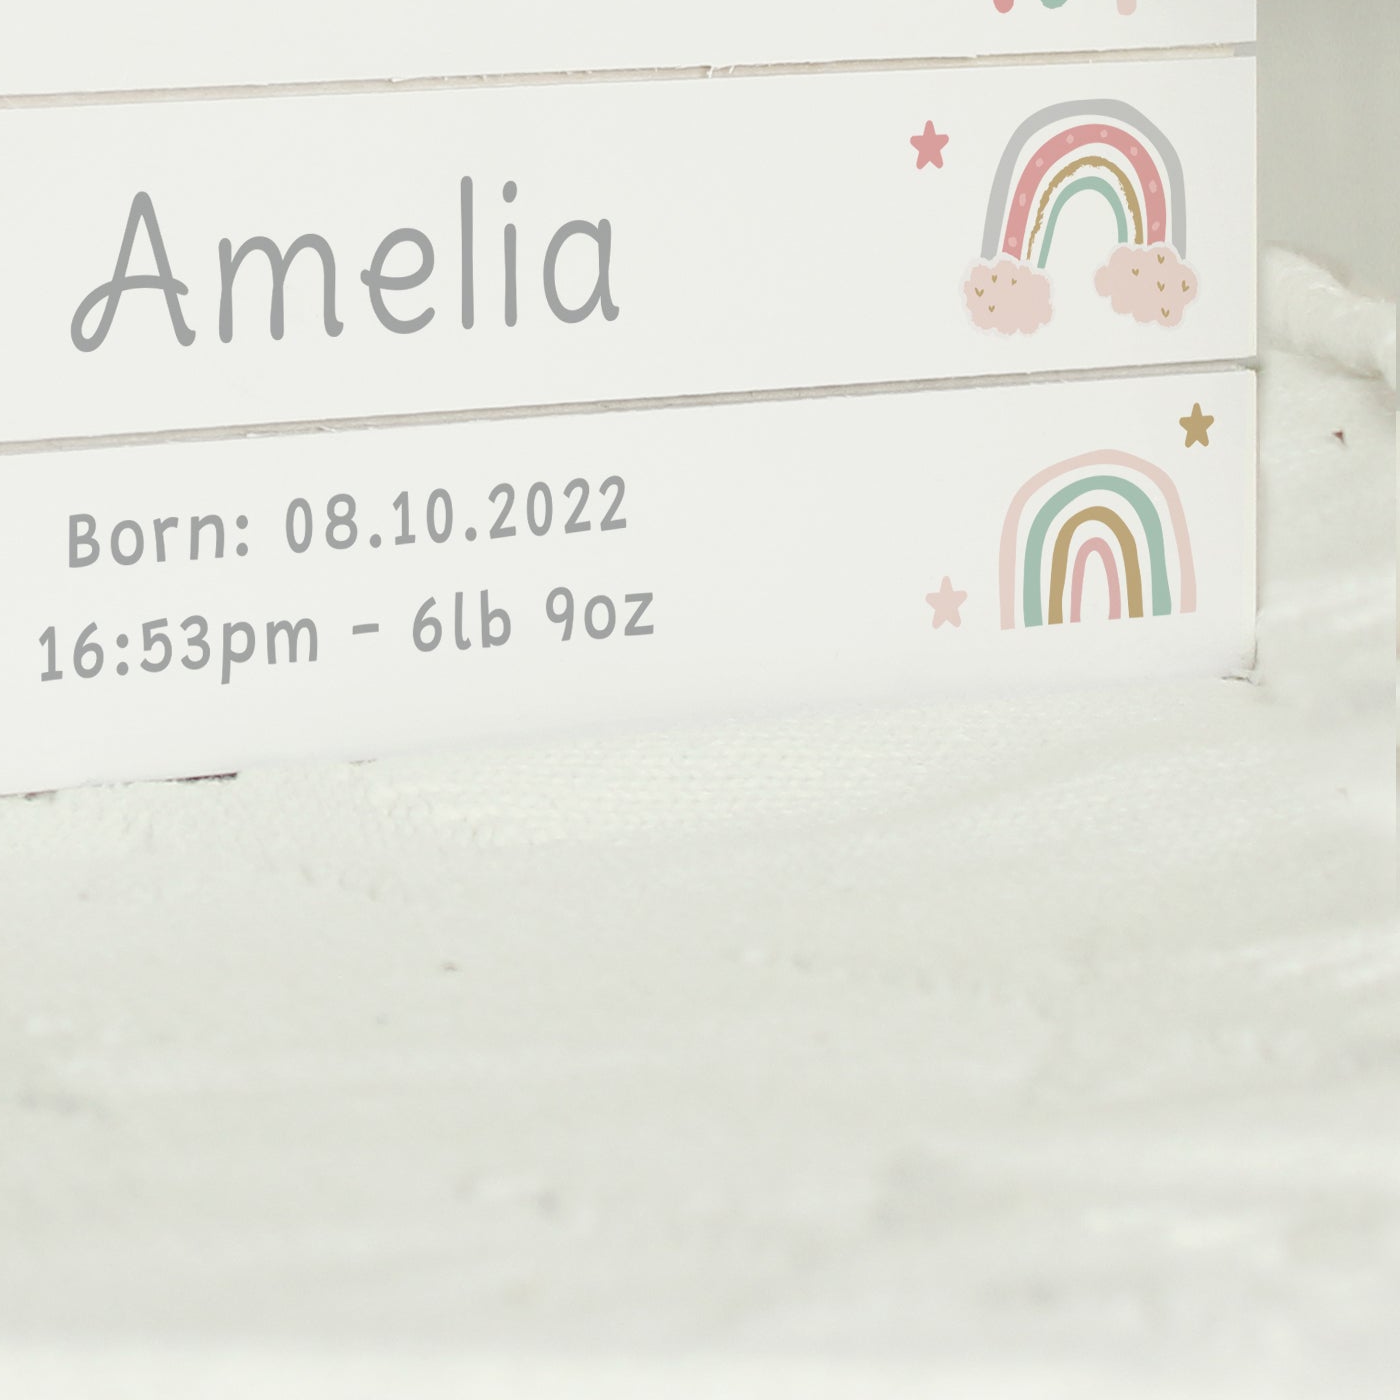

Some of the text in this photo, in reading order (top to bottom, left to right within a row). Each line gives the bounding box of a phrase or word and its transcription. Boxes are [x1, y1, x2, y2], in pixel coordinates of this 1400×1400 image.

[70, 176, 620, 353] Amelia
[68, 475, 627, 569] Born: 08.10.2022
[38, 586, 655, 685] 16:53pm - 6lb 9oz
